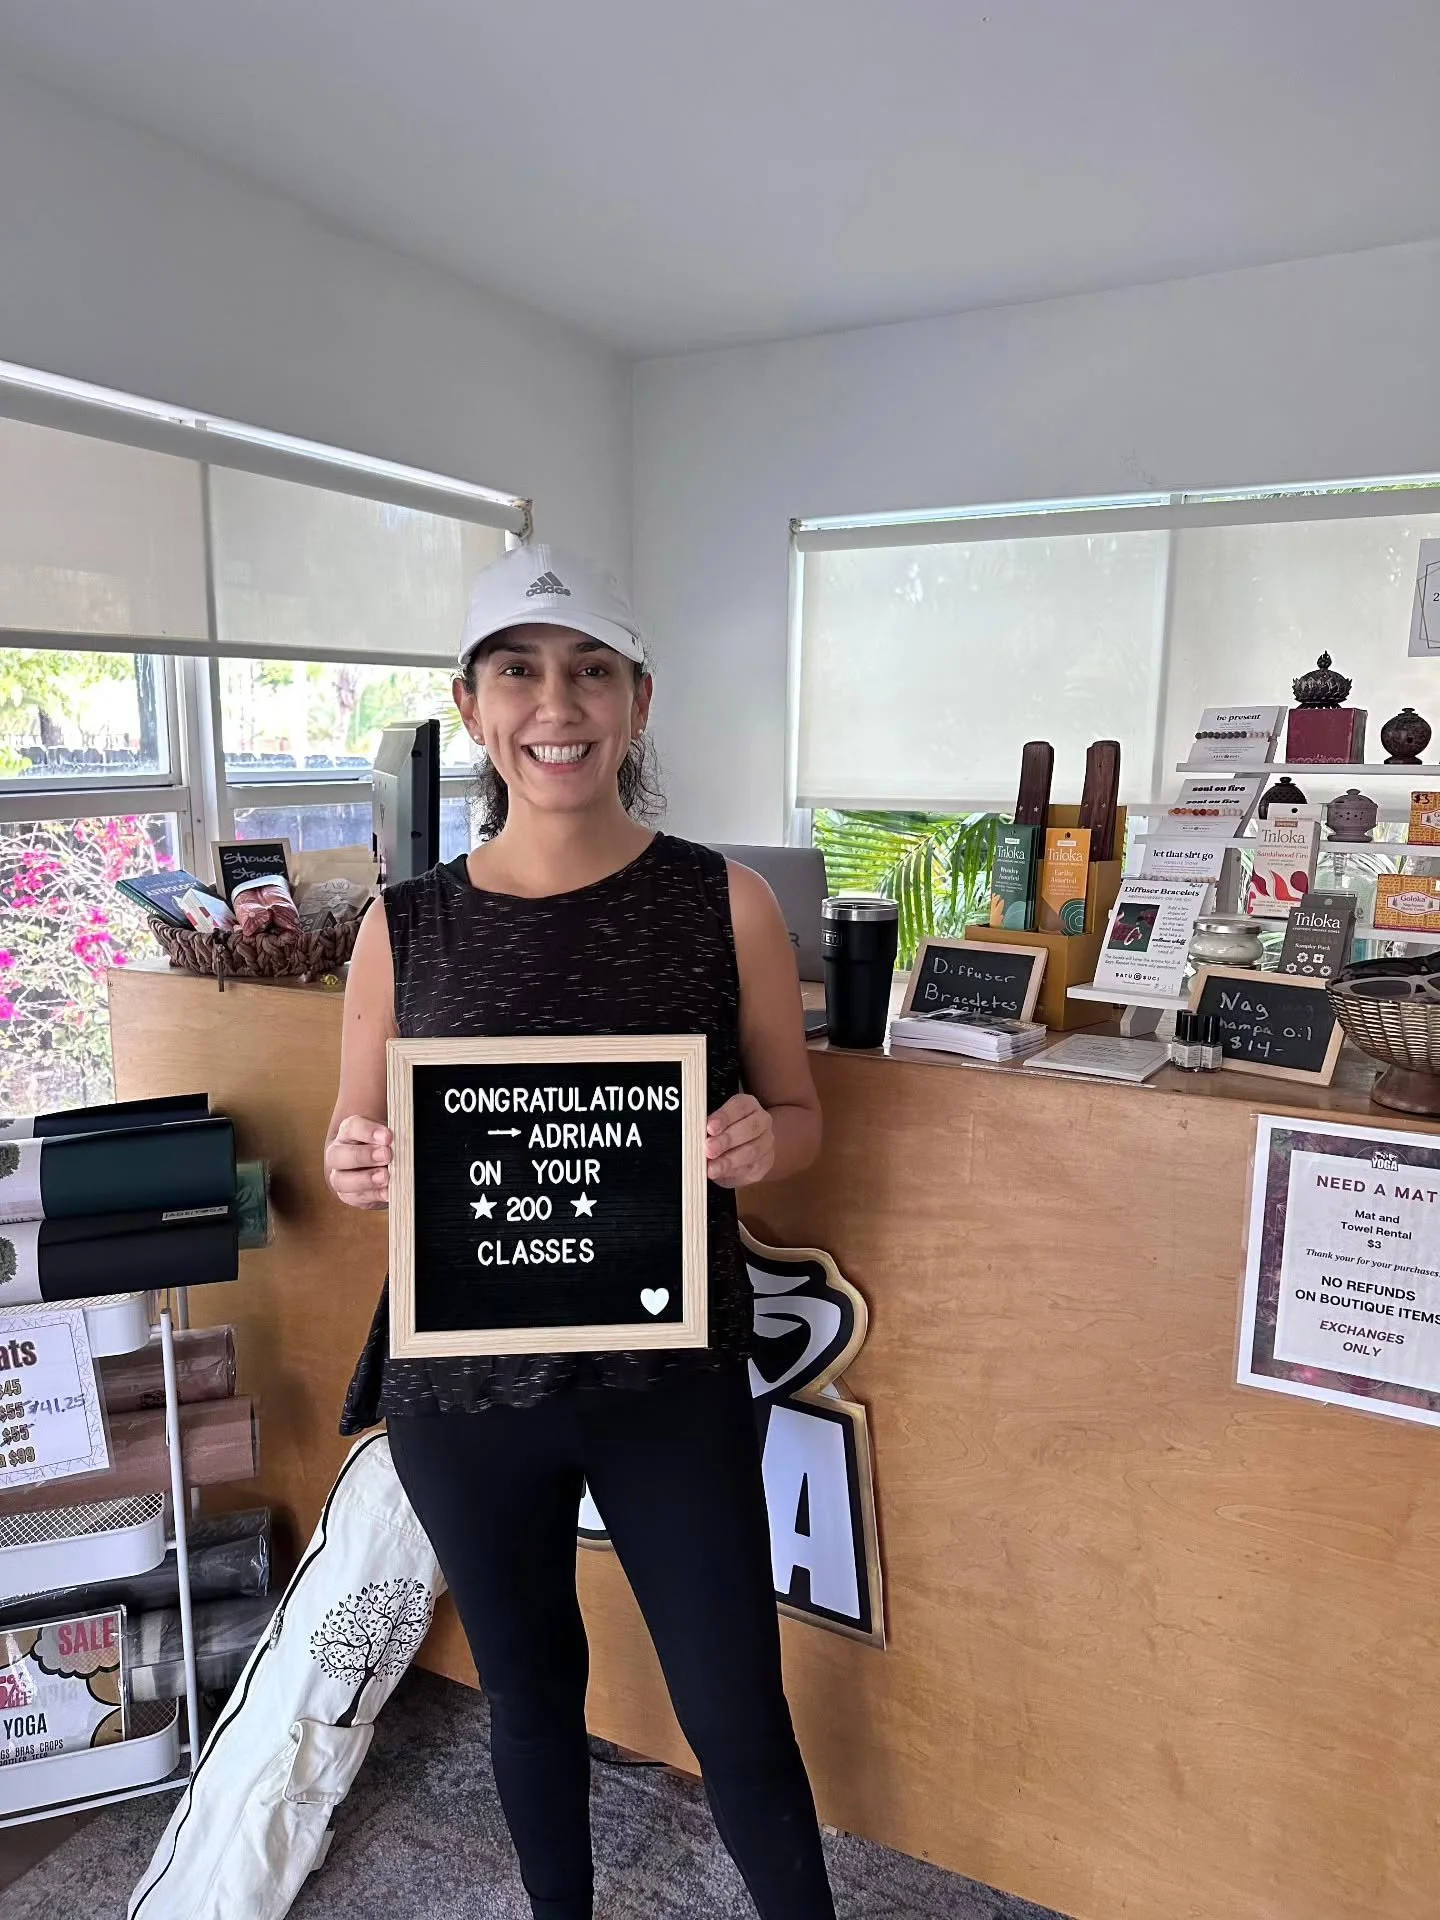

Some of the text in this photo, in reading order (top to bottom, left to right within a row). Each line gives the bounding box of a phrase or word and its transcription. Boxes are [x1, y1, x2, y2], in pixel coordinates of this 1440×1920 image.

[526, 585, 571, 597] adidas
[1229, 714, 1261, 722] present
[1262, 830, 1305, 843] Triloka
[998, 845, 1025, 860] Triloka
[1048, 848, 1083, 862] Triloka
[1166, 850, 1183, 858] that
[145, 882, 200, 897] ASTROLOGY
[1161, 888, 1200, 897] Bracelets
[1294, 912, 1340, 929] Triloka
[933, 957, 1017, 983] Diffuser
[1220, 992, 1270, 1021] Nag
[1220, 1017, 1312, 1041] hampa Oil
[444, 1086, 680, 1114] CONGRATULATIONS
[528, 1122, 643, 1149] ADRIANA
[469, 1159, 601, 1186] ON YOUR
[1372, 1158, 1398, 1171] YOGA
[1316, 1175, 1438, 1203] NEED A MAT
[506, 1196, 552, 1222] 200
[1354, 1210, 1400, 1224] Mat and
[1341, 1221, 1412, 1240] Towel Rental
[477, 1238, 595, 1266] CLASSES
[1367, 1239, 1382, 1249] $3
[1306, 1248, 1440, 1278] Thank your for your purchases.
[1321, 1276, 1416, 1301] NO REFUNDS
[1295, 1289, 1440, 1325] ON BOUTIQUE ITEMS
[1320, 1320, 1405, 1345] EXCHANGES
[1343, 1342, 1382, 1357] ONLY
[2, 1426, 30, 1445] $55
[9, 1446, 36, 1467] $99
[58, 1616, 115, 1656] SALE
[3, 1713, 48, 1740] YOGA
[15, 1744, 35, 1758] BRAS
[39, 1739, 64, 1752] CROPS
